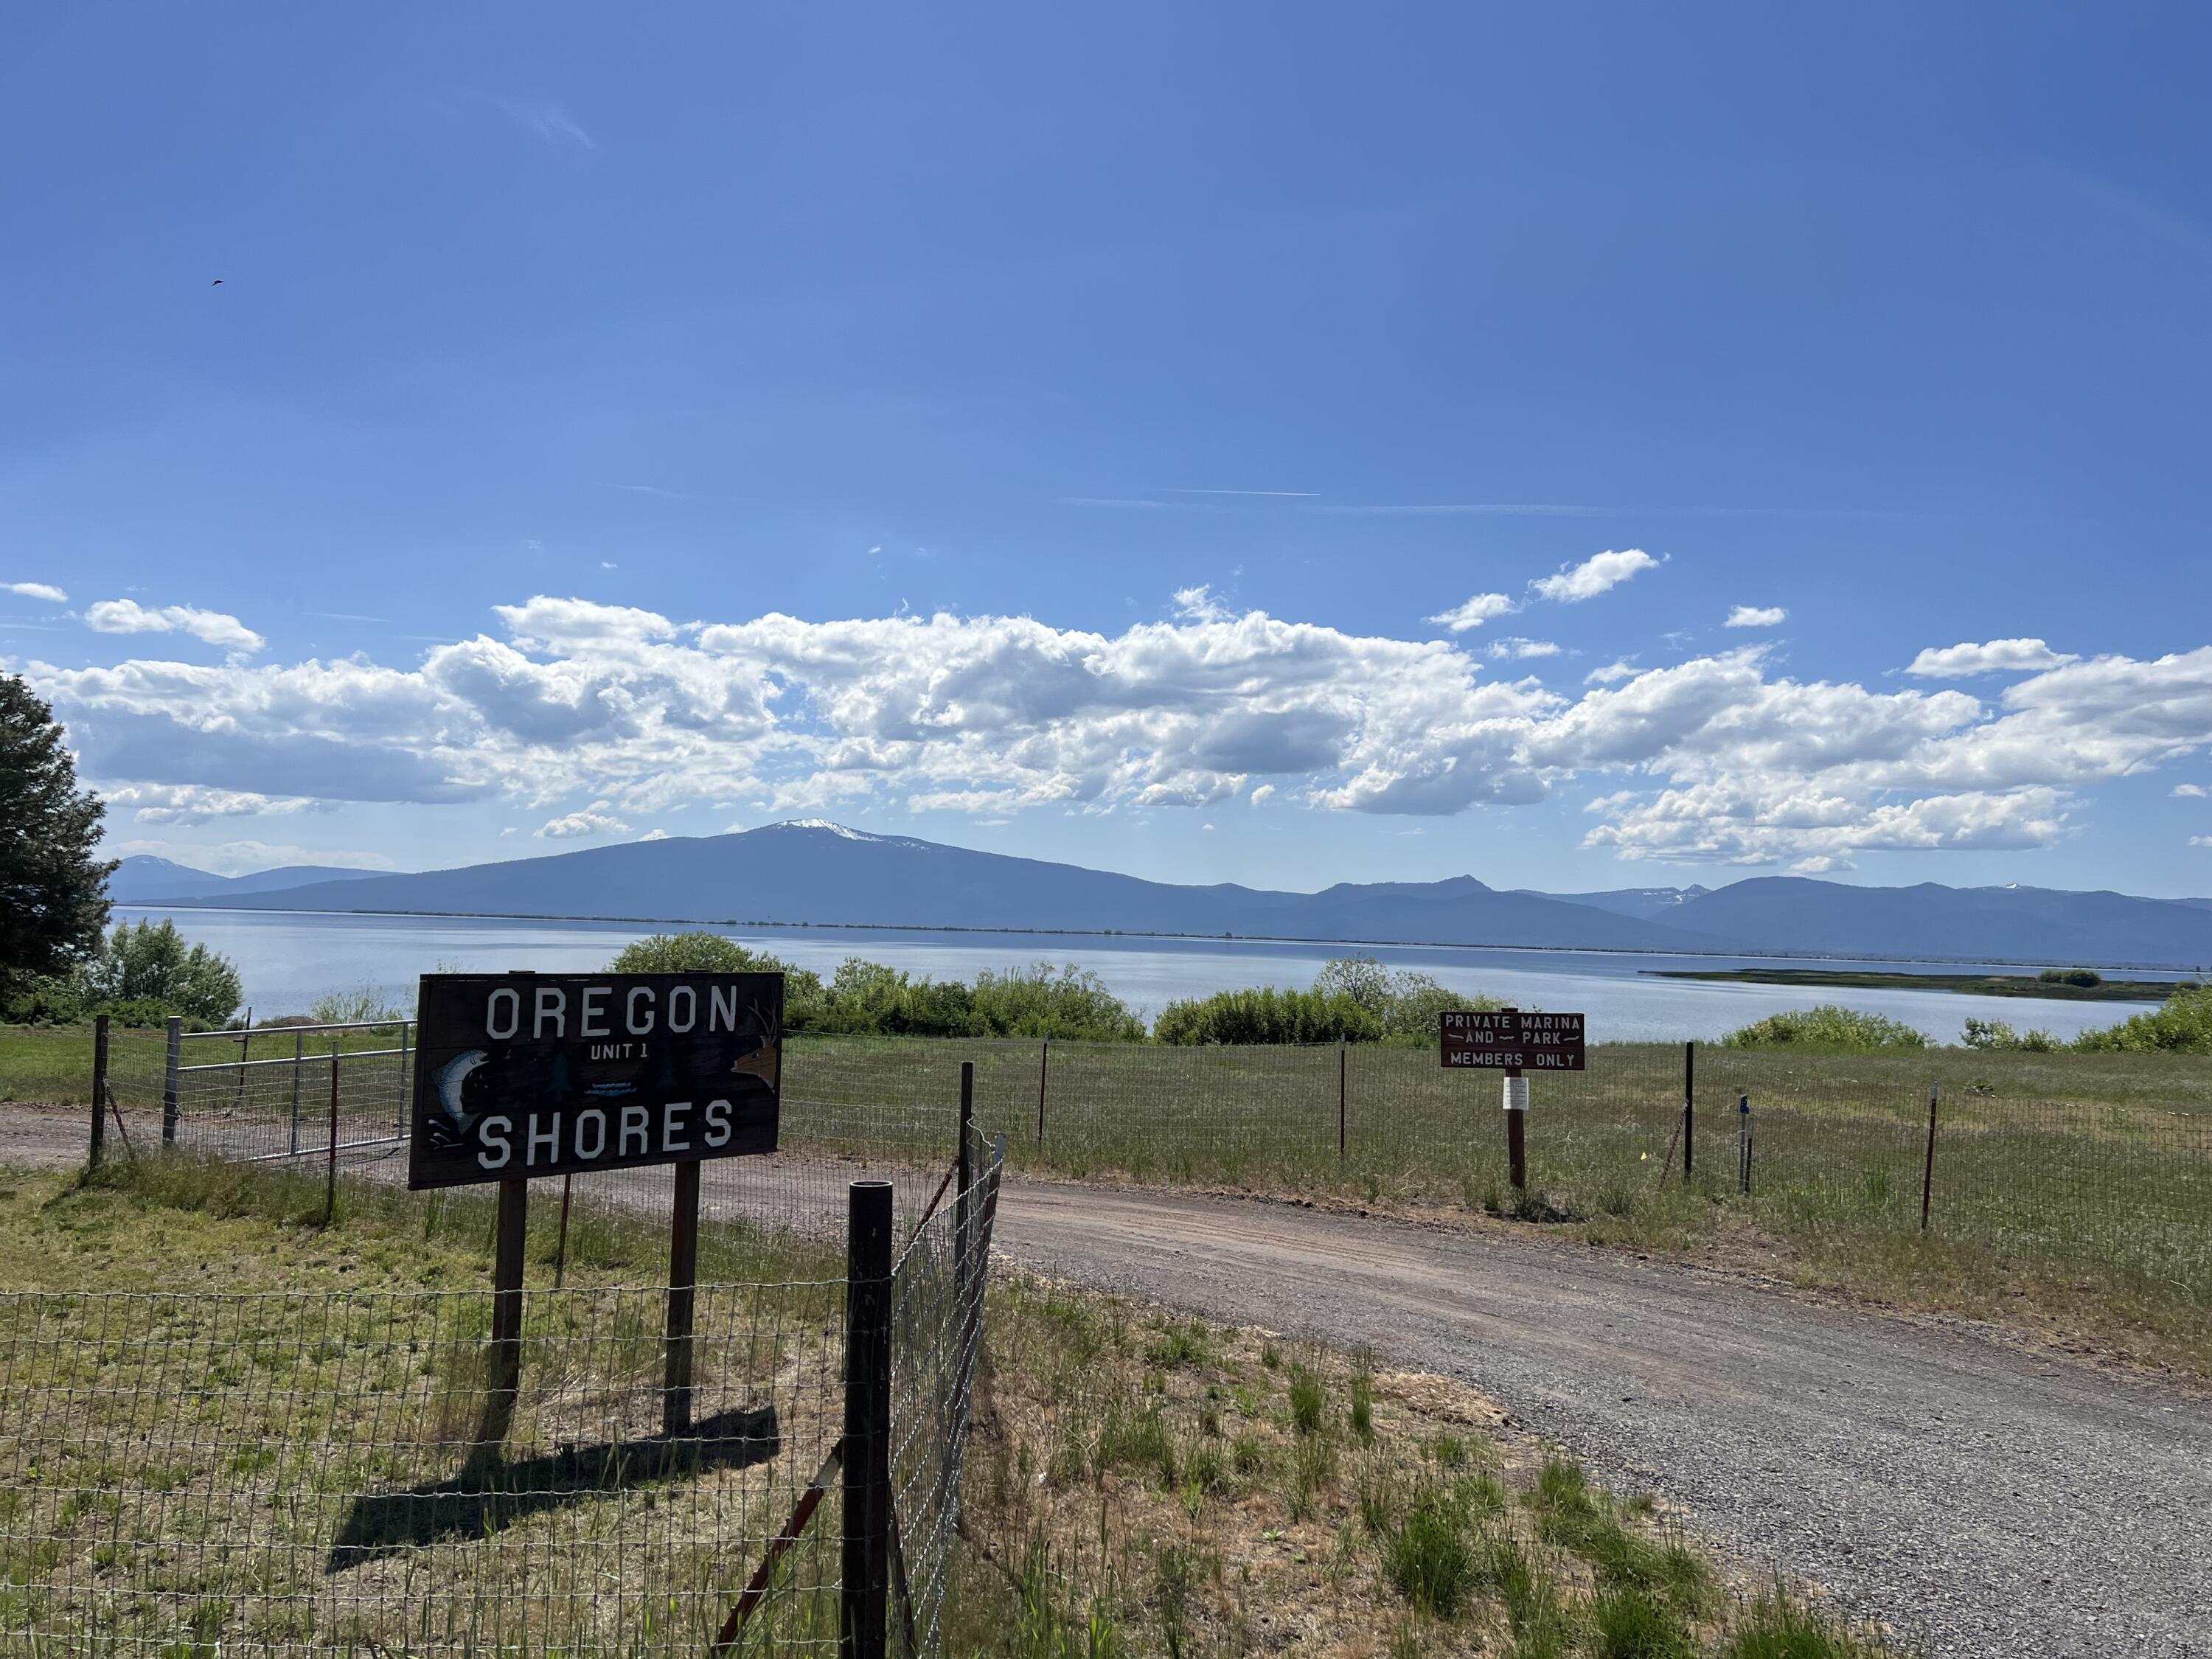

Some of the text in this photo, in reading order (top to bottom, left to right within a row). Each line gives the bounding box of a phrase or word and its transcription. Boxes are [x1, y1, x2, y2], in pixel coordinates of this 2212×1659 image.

[487, 985, 737, 1039] OREGON
[1445, 1015, 1579, 1029] PRIVATE MARINA
[1465, 1031, 1560, 1044] AND PARK
[591, 1043, 648, 1060] UNIT 1
[1450, 1052, 1574, 1067] MEMBERS ONLY
[478, 1099, 732, 1169] SHORES
